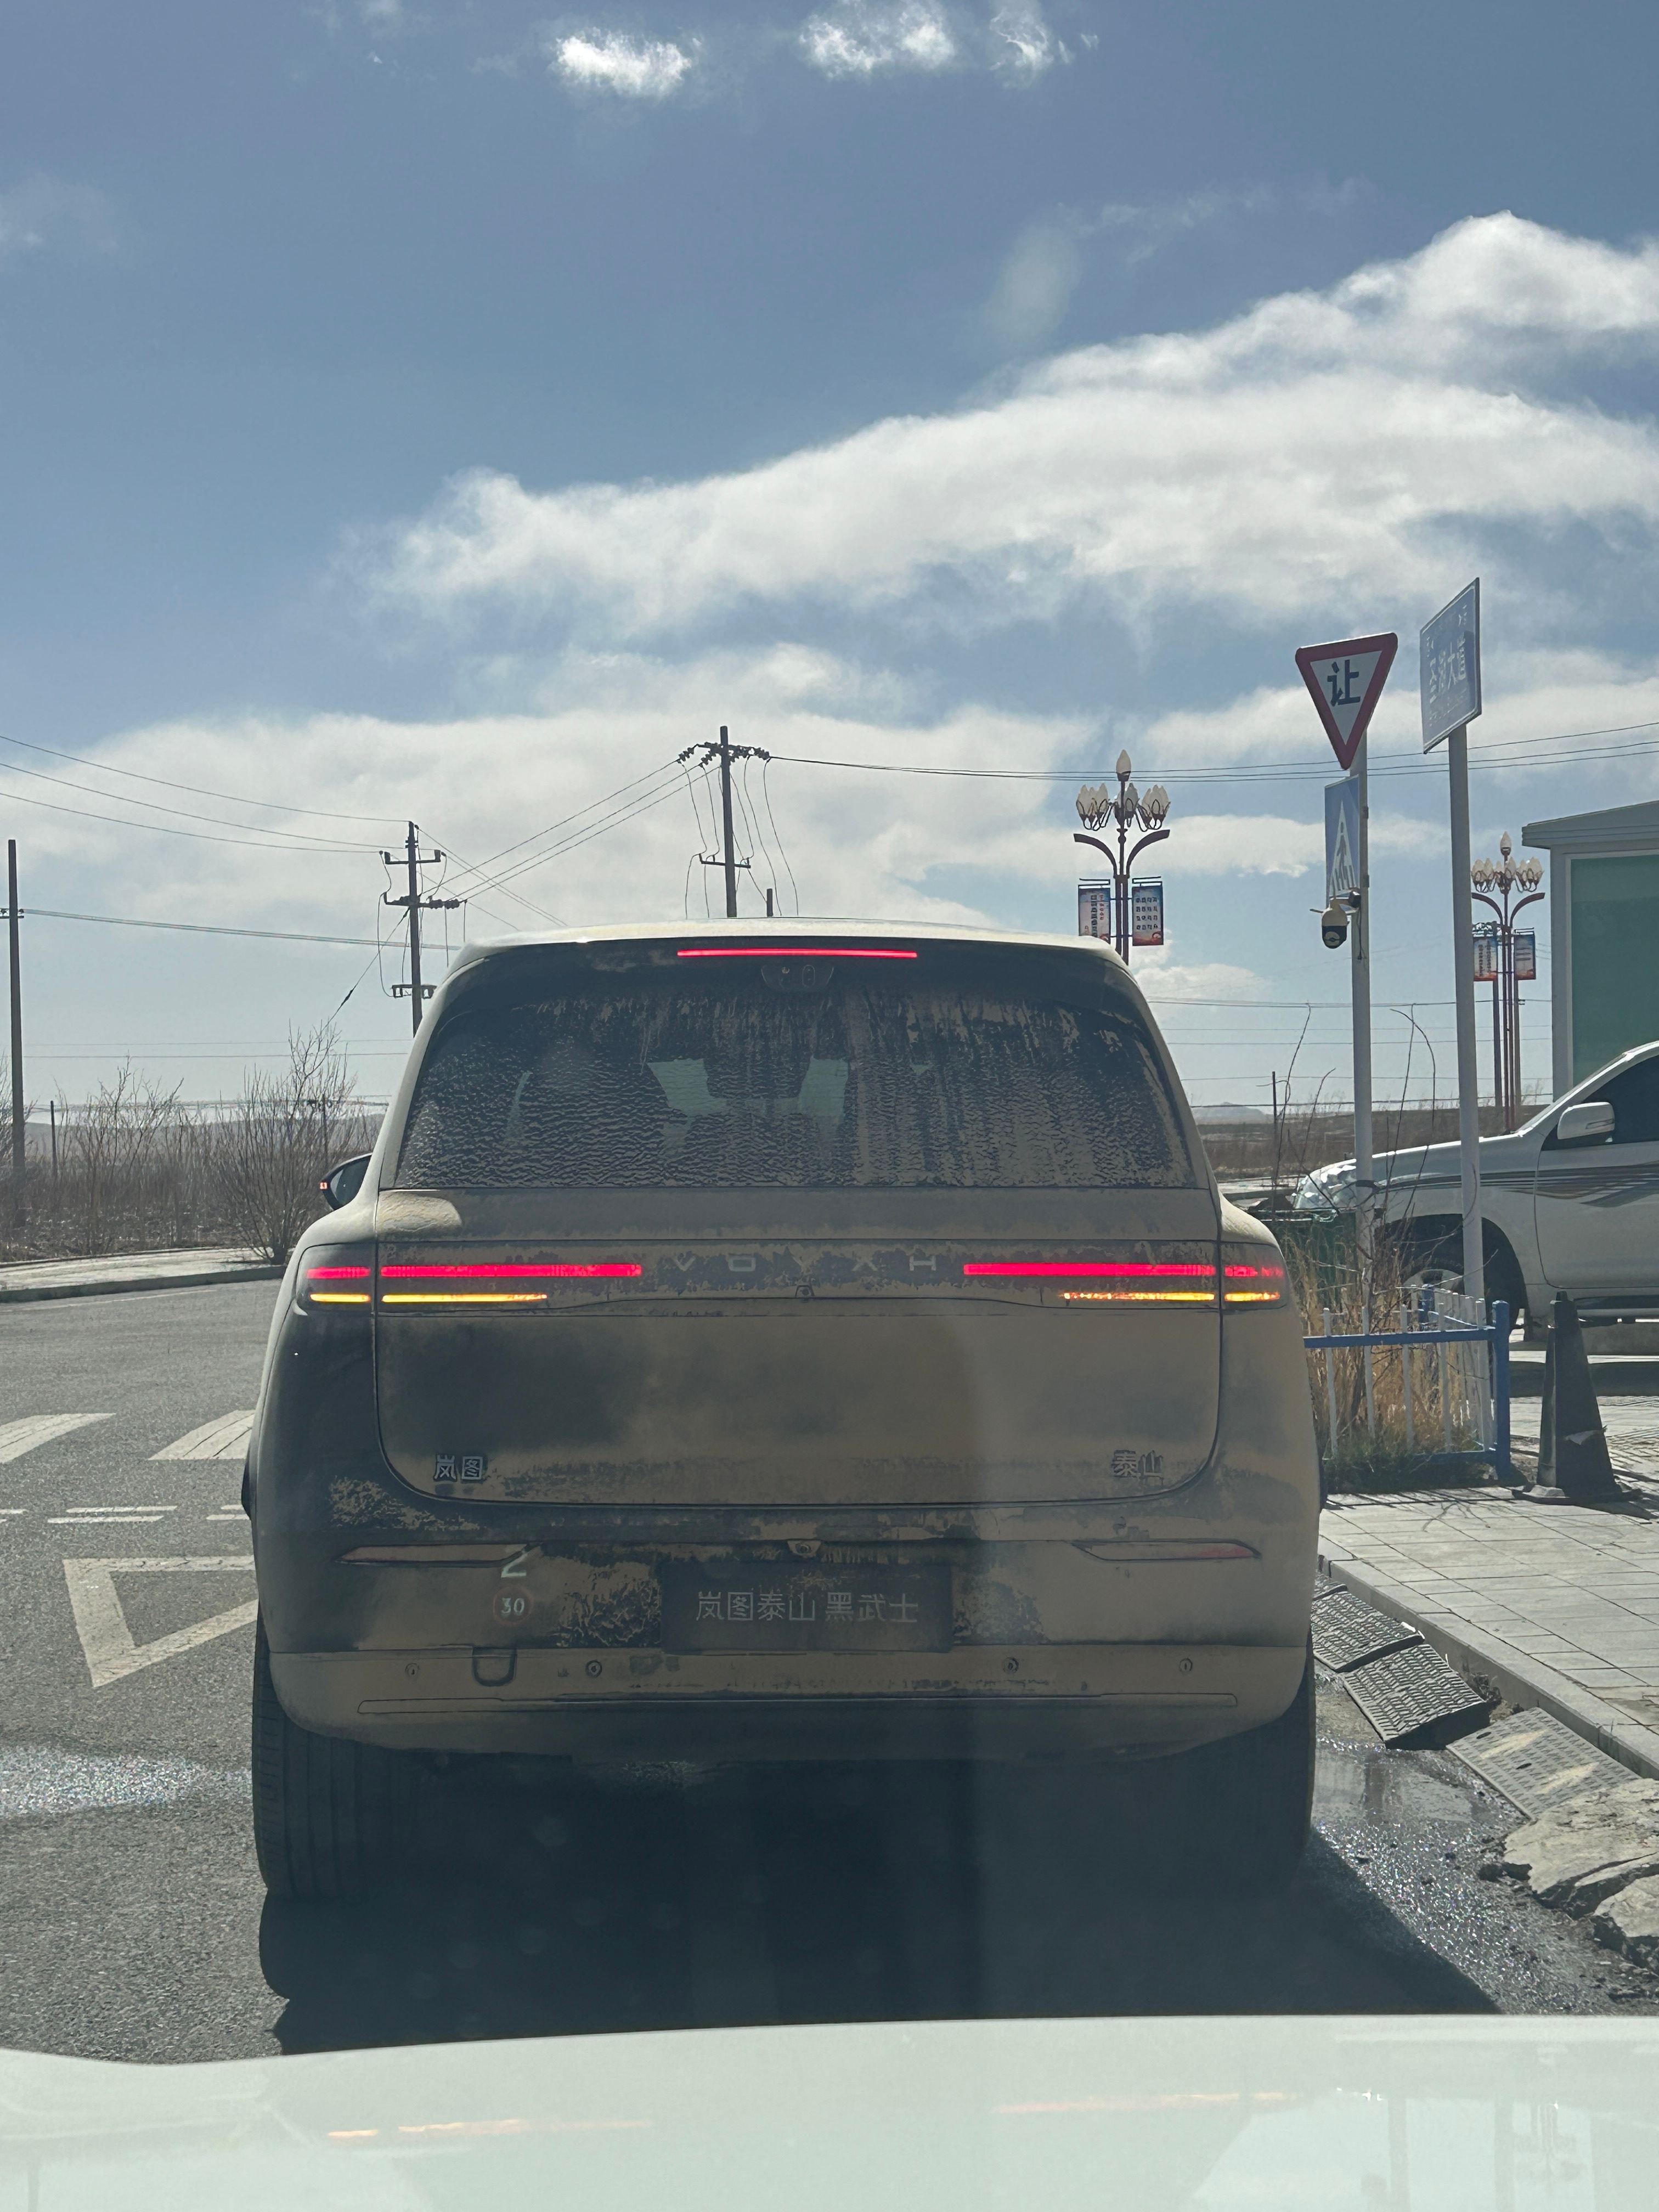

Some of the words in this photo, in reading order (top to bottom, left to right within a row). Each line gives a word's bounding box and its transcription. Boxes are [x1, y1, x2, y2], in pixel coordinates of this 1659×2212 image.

[1327, 659, 1361, 707] 让
[433, 1454, 483, 1480] 岚图
[1113, 1451, 1163, 1478] 泰山
[501, 1597, 525, 1617] 30
[697, 1591, 815, 1621] 岚图泰山
[825, 1592, 918, 1623] 黑武士
